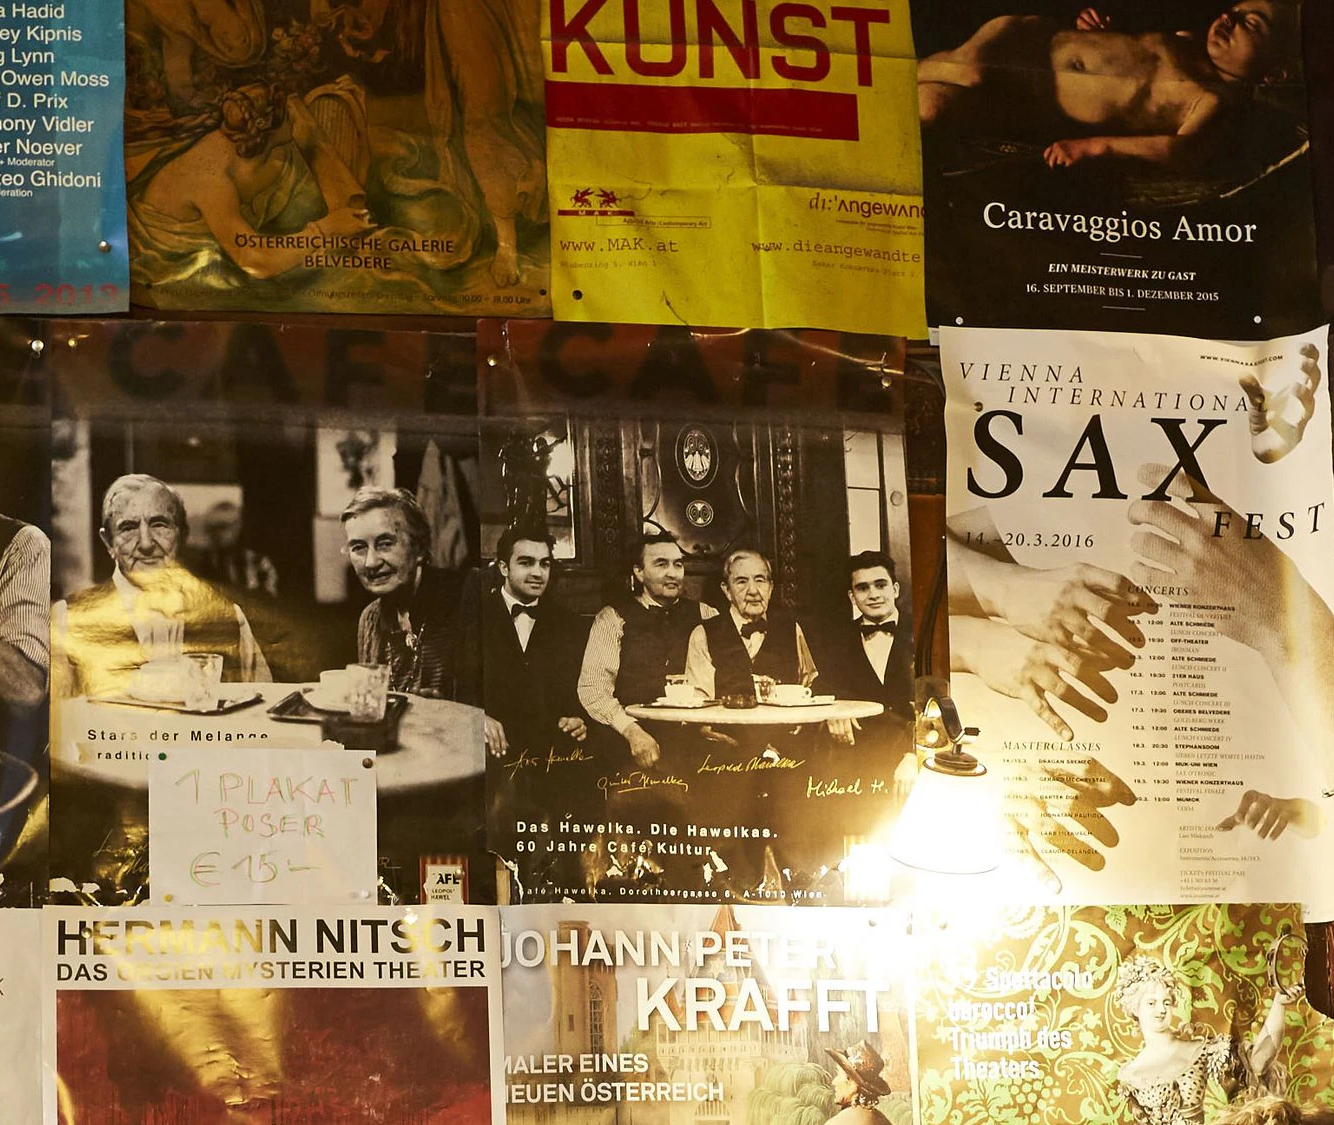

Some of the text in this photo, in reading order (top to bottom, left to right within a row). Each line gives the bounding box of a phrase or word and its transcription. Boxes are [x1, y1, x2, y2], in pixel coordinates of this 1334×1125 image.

[12, 2, 64, 20] Hadid
[26, 26, 82, 46] Kipnis
[550, 0, 890, 87] KUNST
[11, 48, 55, 64] Lynn
[1, 70, 55, 86] Owen
[60, 71, 109, 87] Moss
[7, 93, 27, 108] D.
[33, 93, 68, 109] Prix
[42, 116, 94, 134] Vidler
[16, 139, 83, 156] Noever
[31, 171, 101, 188] Ghidoni
[983, 202, 1257, 243] Caravaggios Amor
[235, 233, 454, 253] ÖSTERREICHISCHE GALERIE
[560, 238, 679, 253] www.MAK.at
[304, 255, 392, 270] BELVEDERE
[1049, 263, 1196, 281] EIN MEISTERWERK ZU GAST
[1043, 284, 1219, 301] SEPTEMBER BIS DEZEMBER 2015
[960, 362, 1083, 384] VIENNA
[967, 410, 1227, 502] SAX
[1212, 502, 1325, 541] FEST
[1128, 585, 1189, 597] CONCERTS
[150, 730, 179, 741] der
[219, 777, 358, 806] PLAKAT
[516, 821, 778, 838] Das Hawelka. Die Hawelkas.
[516, 840, 647, 854] 60 Jahre Café
[56, 917, 485, 956] HERMANN NITSCH
[503, 929, 836, 968] JOHANN PETER
[56, 963, 107, 982] DAS
[218, 961, 364, 980] MYSTERIEN
[373, 960, 485, 979] THEATER
[636, 977, 889, 1032] KRAFFT
[1038, 1027, 1073, 1050] des
[579, 1052, 649, 1073] EINES
[951, 1056, 1039, 1080] Theaters
[580, 1079, 724, 1102] ÖSTERREICH
